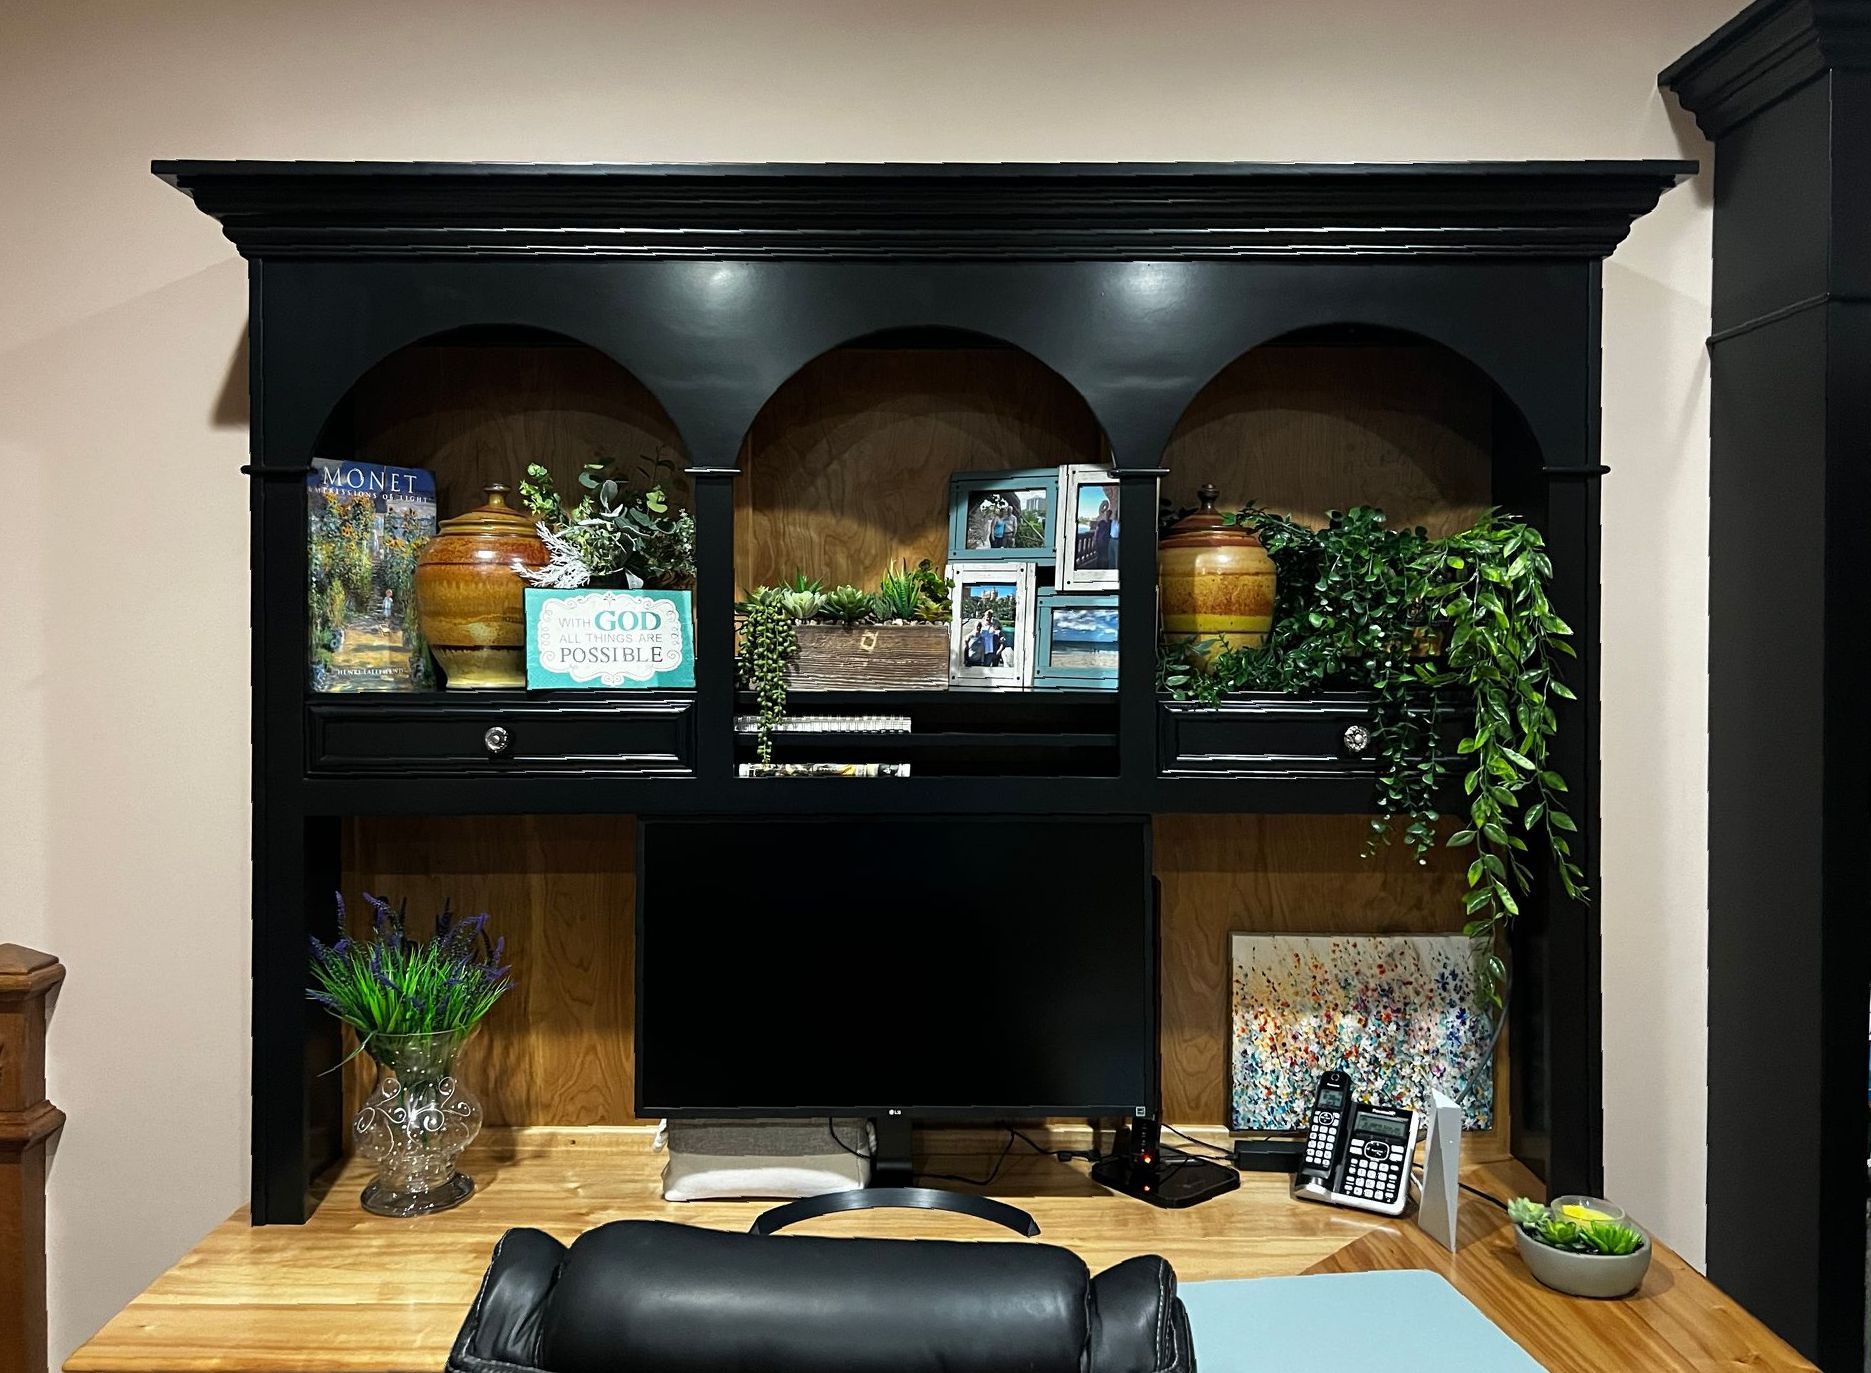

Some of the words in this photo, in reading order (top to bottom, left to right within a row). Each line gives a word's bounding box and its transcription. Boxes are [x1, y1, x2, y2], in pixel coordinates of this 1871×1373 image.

[322, 466, 417, 494] MONET
[558, 617, 591, 628] WITH
[594, 610, 662, 631] GOD
[559, 633, 581, 643] ALL
[586, 633, 633, 643] THINGS
[638, 633, 663, 643] ARE
[559, 646, 663, 663] POSSIBLE
